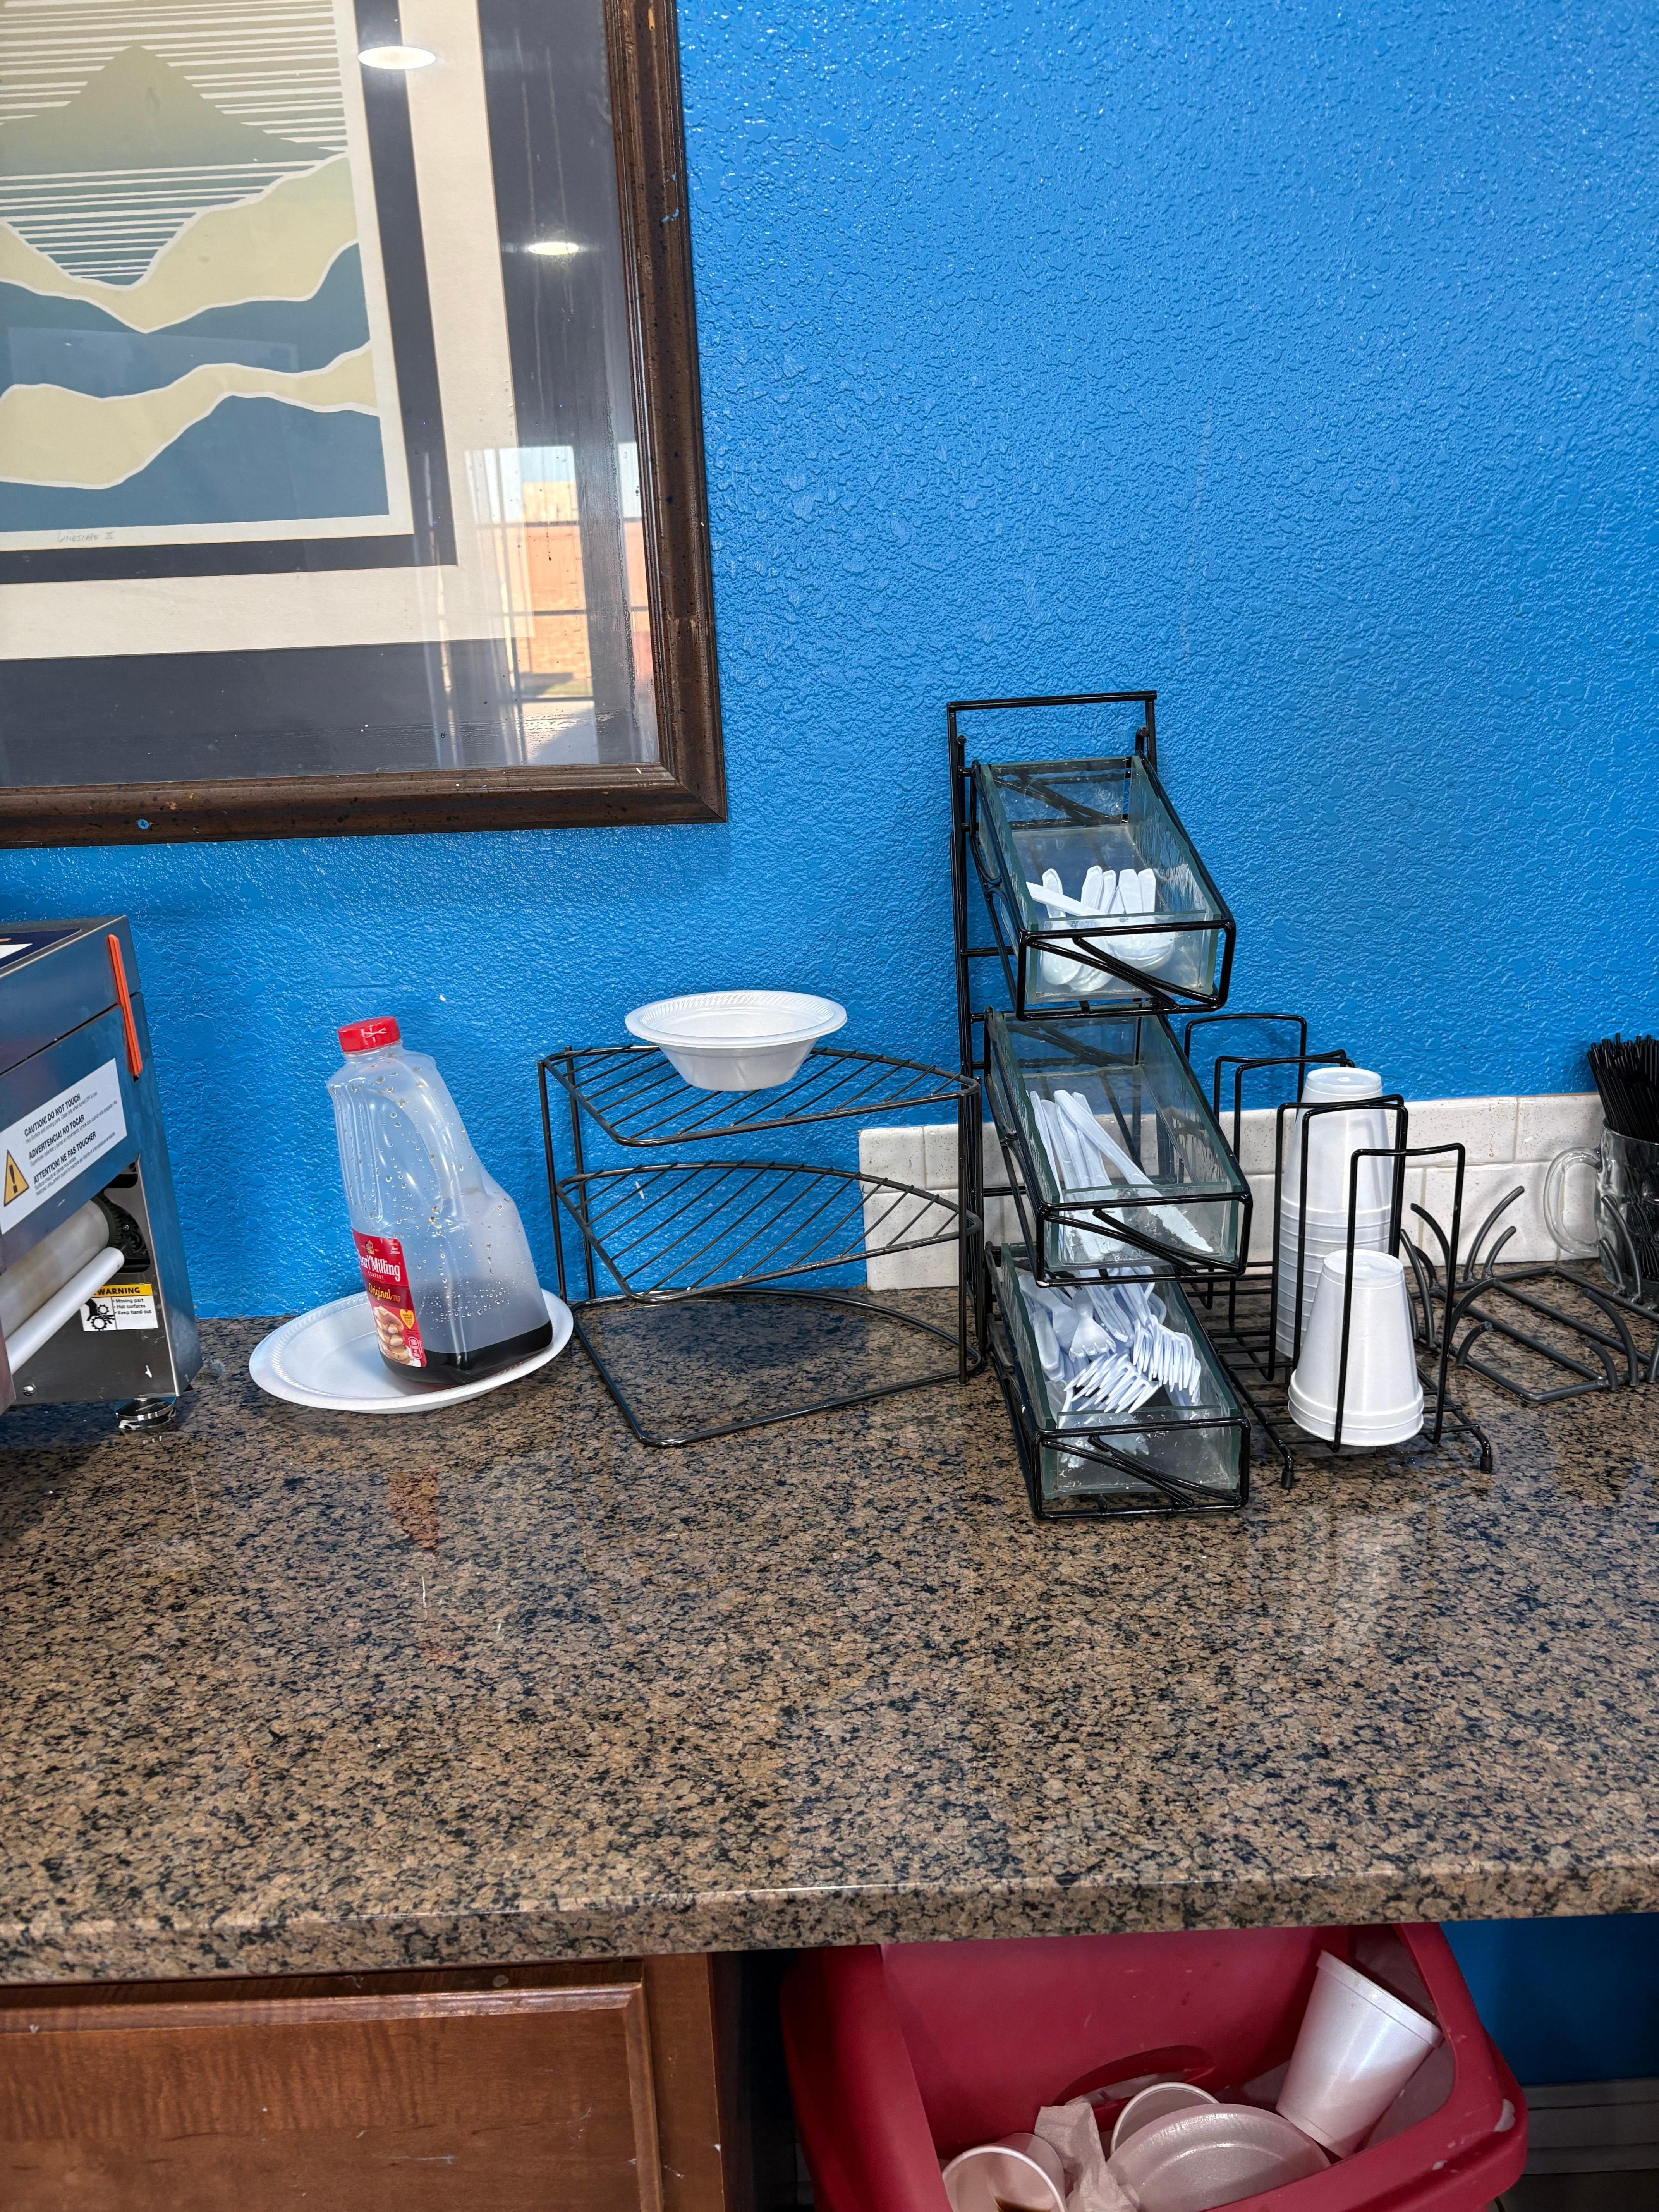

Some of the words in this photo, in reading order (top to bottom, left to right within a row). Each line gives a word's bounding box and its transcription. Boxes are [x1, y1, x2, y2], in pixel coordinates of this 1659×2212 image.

[24, 1116, 47, 1137] CAUTION!
[47, 1111, 55, 1121] DO
[55, 1104, 65, 1116] NOT
[65, 1093, 81, 1109] TOUCH
[29, 1132, 62, 1160] ADVERTENCIA!
[62, 1125, 69, 1135] NO
[69, 1114, 85, 1130] TOCAR
[34, 1158, 60, 1184] ATTENTION!
[60, 1153, 67, 1164] NE
[67, 1146, 76, 1159] PAS
[76, 1131, 97, 1151] TOUCHER
[369, 1283, 392, 1300] Original
